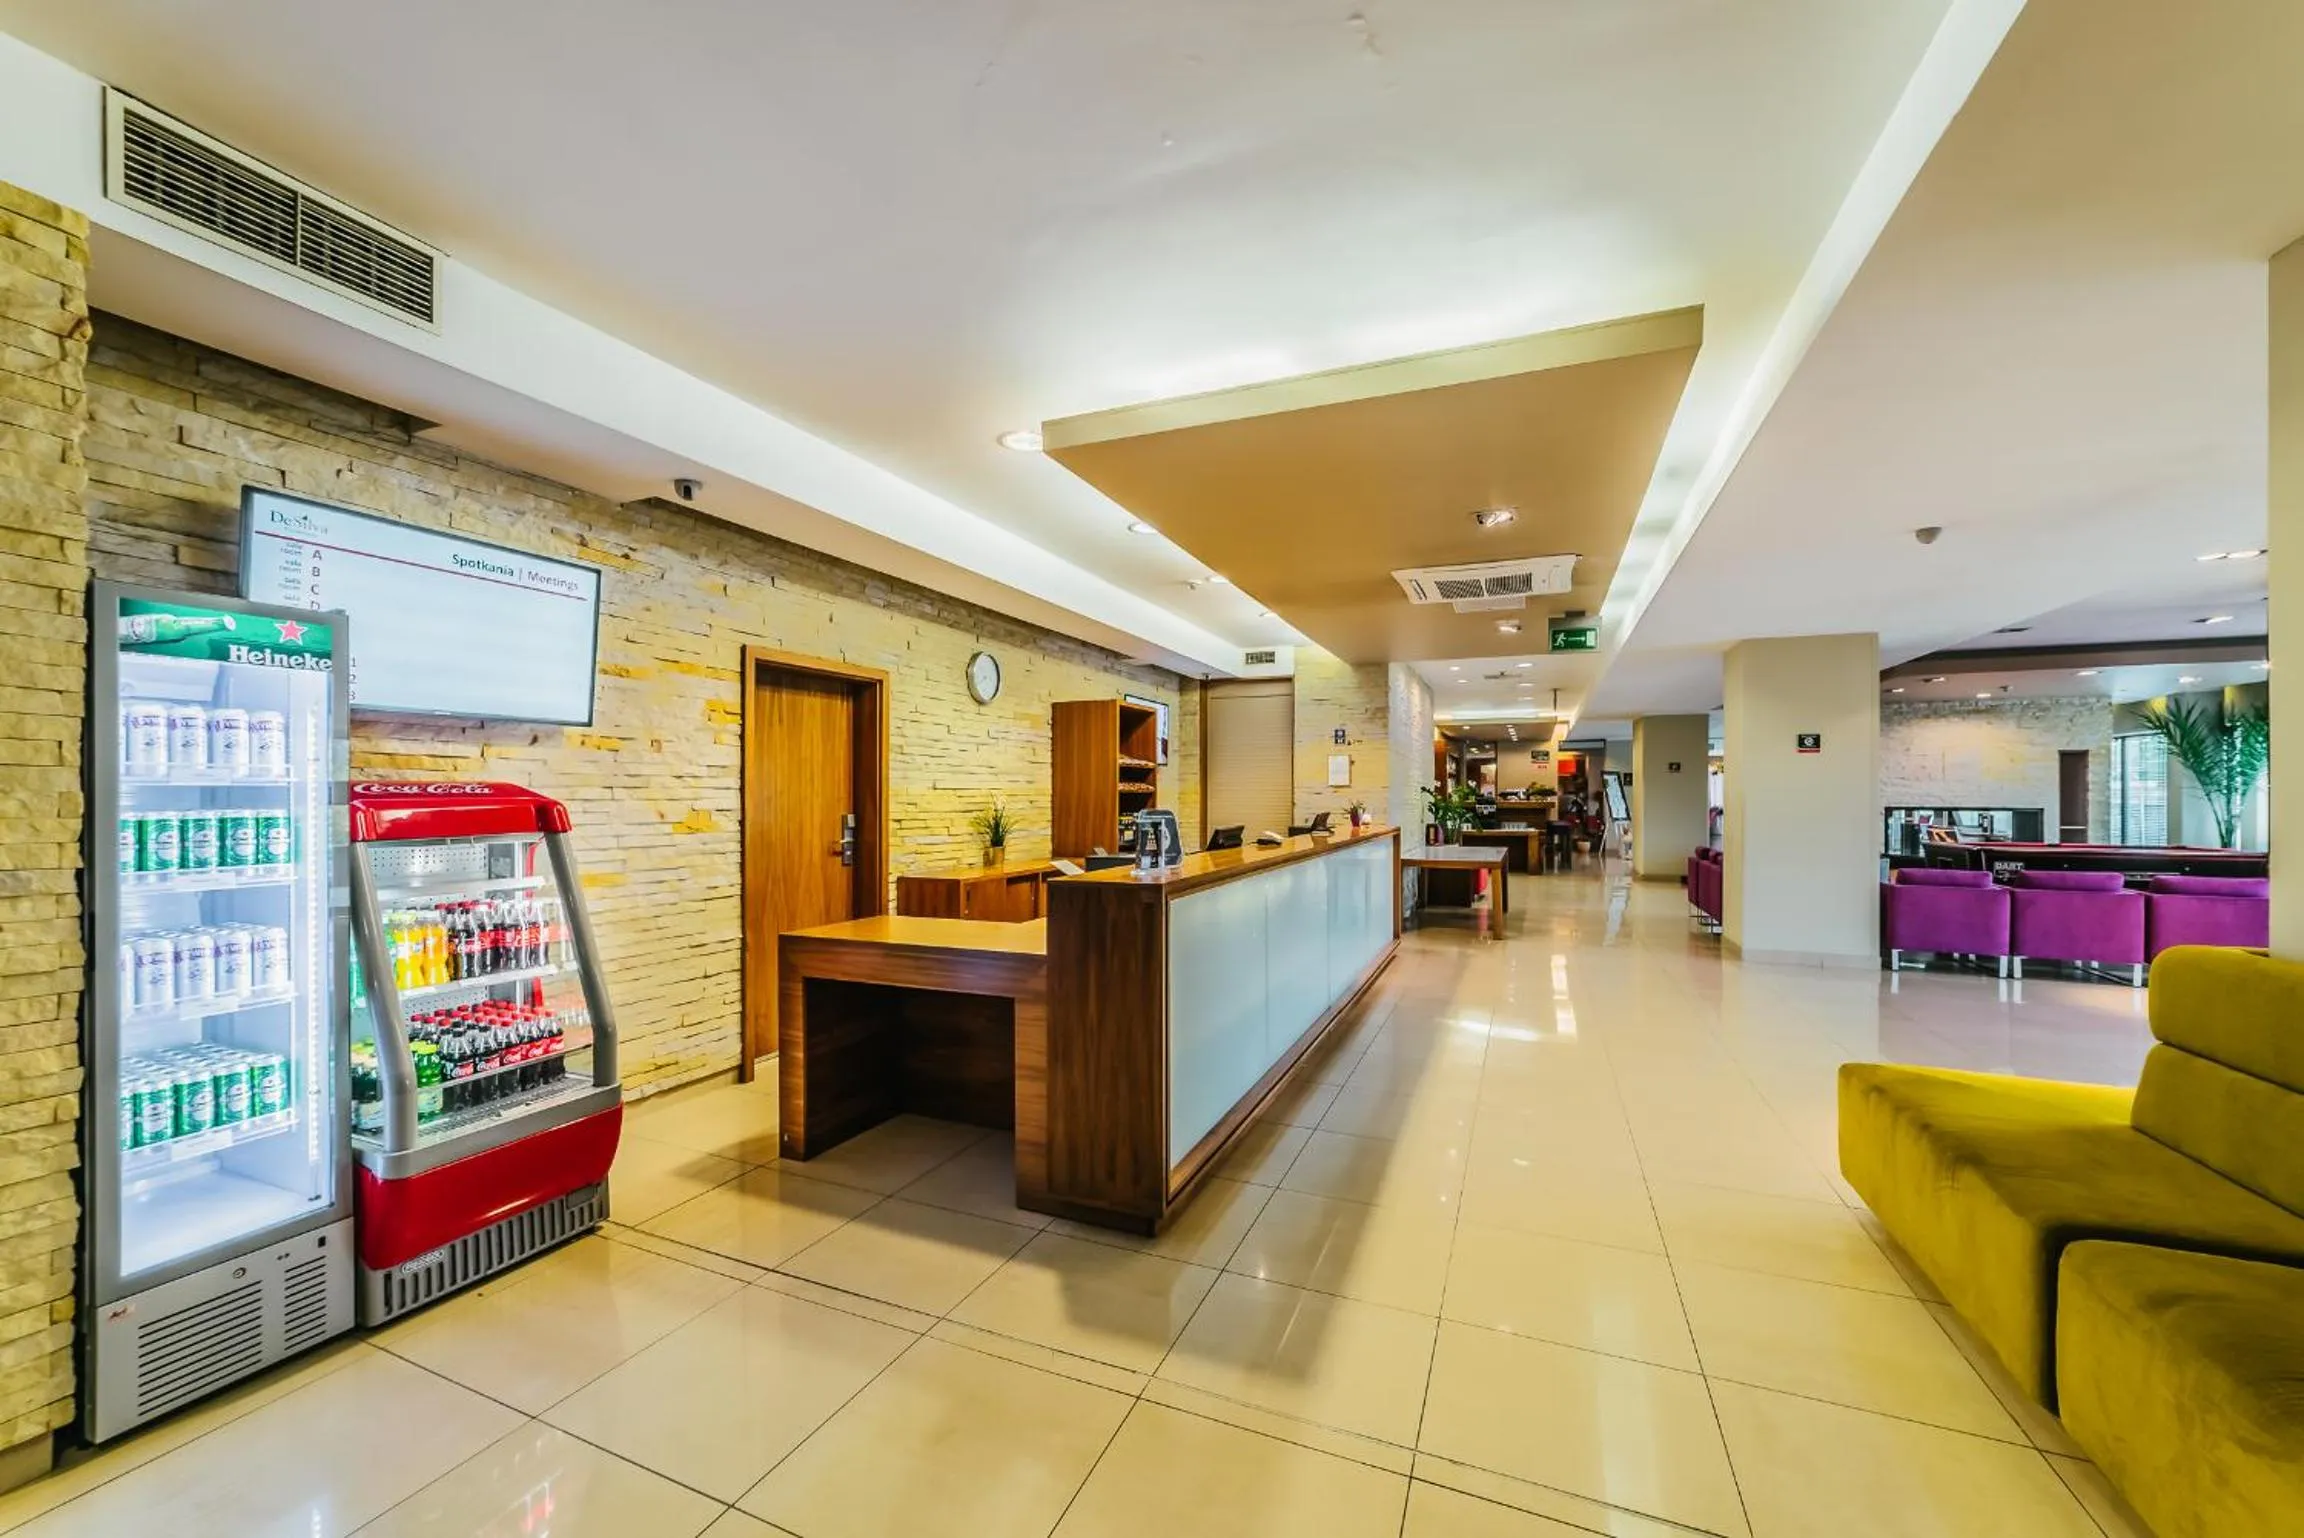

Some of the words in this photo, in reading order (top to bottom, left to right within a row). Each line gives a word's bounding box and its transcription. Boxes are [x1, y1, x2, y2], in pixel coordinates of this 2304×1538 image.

[312, 549, 322, 560] A
[311, 566, 321, 577] B
[452, 554, 514, 577] Spotkania
[527, 571, 579, 592] Meetings
[310, 584, 320, 595] C
